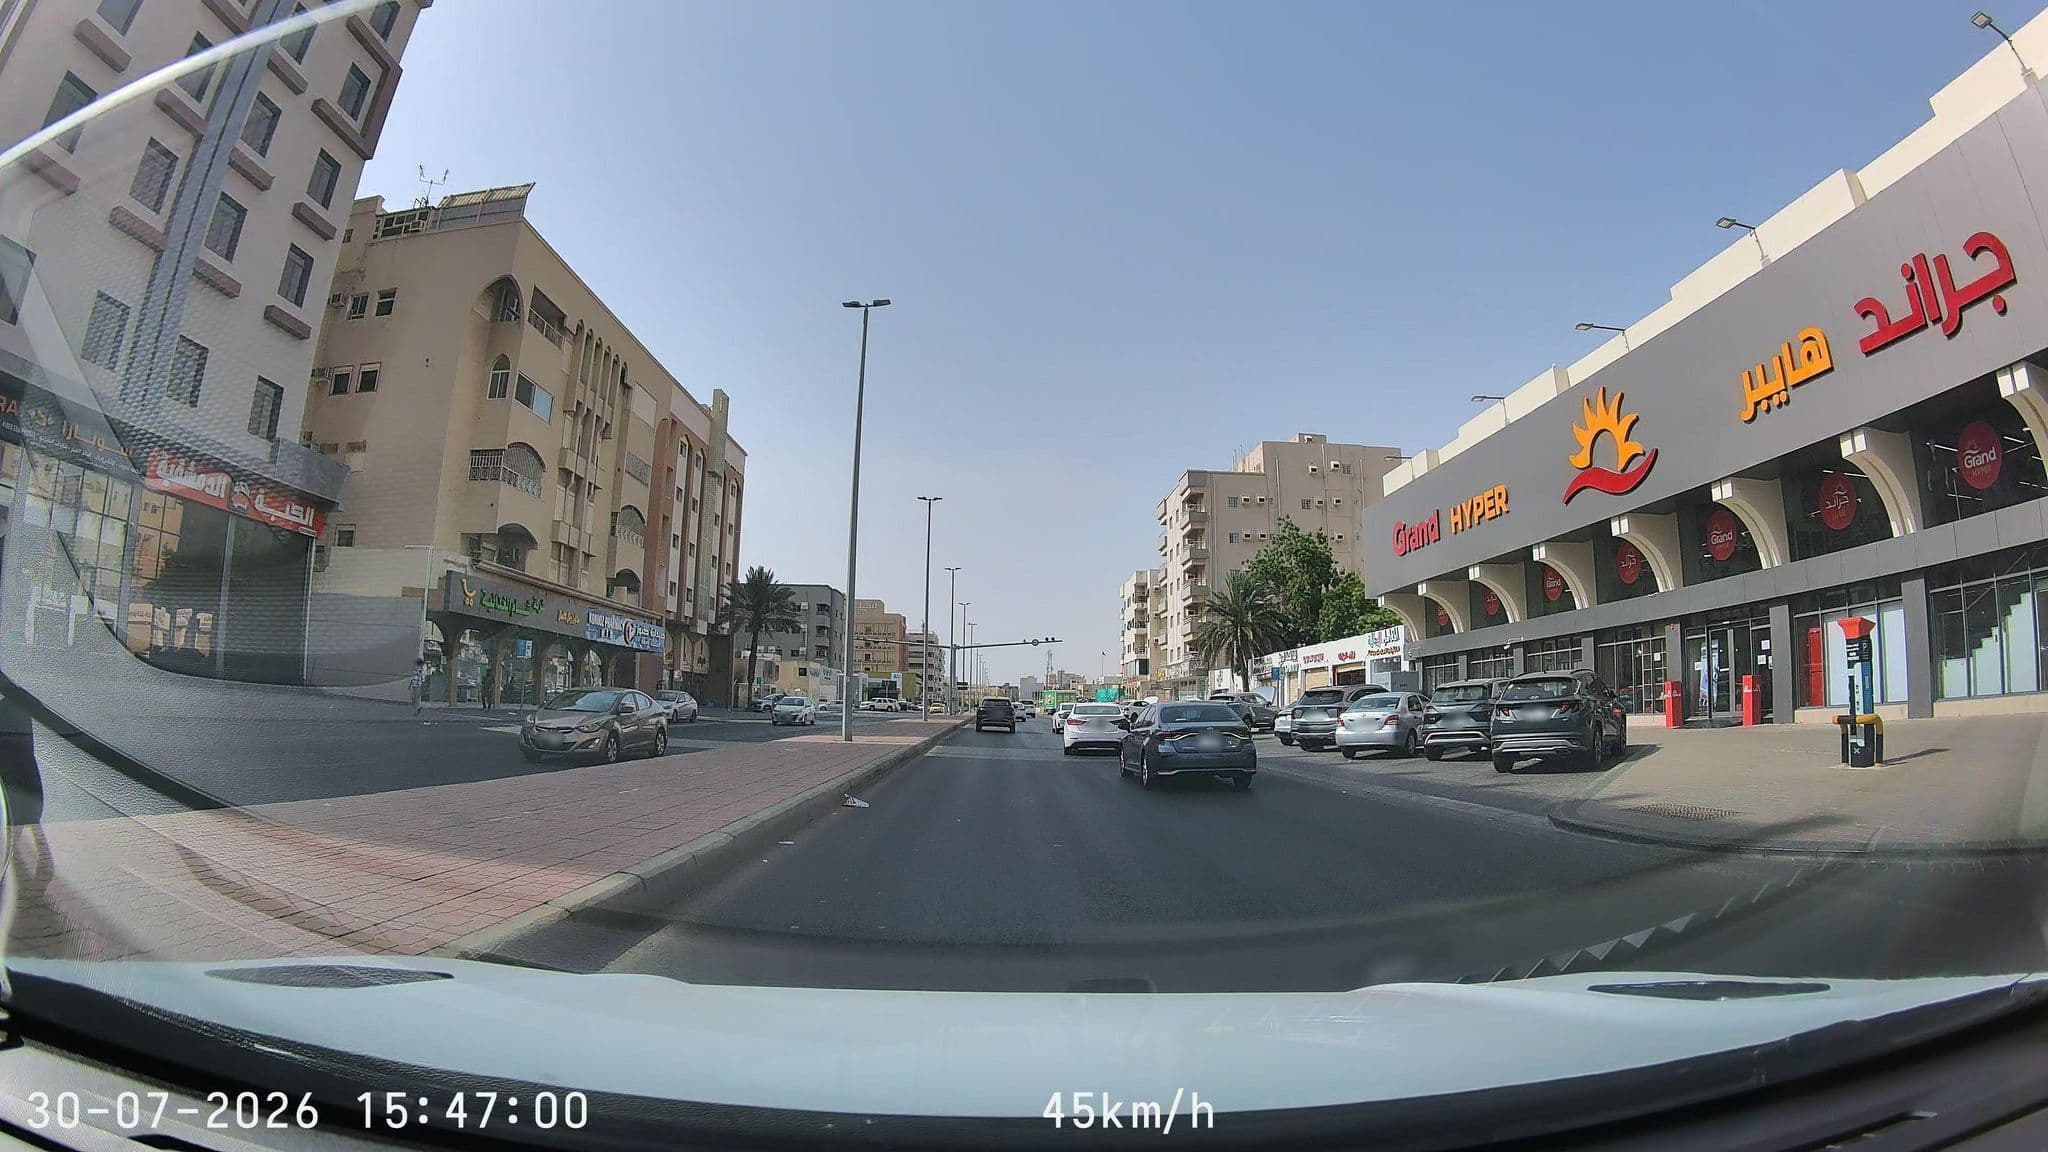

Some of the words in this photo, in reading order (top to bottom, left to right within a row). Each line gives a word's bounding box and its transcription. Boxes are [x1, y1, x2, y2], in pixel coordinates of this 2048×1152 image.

[1854, 231, 2017, 357] جراند
[1740, 327, 1834, 424] هايبر
[1964, 446, 1997, 469] Grand
[1393, 509, 1441, 557] Grand
[1449, 484, 1510, 535] HYPER
[1711, 529, 1733, 545] Grand
